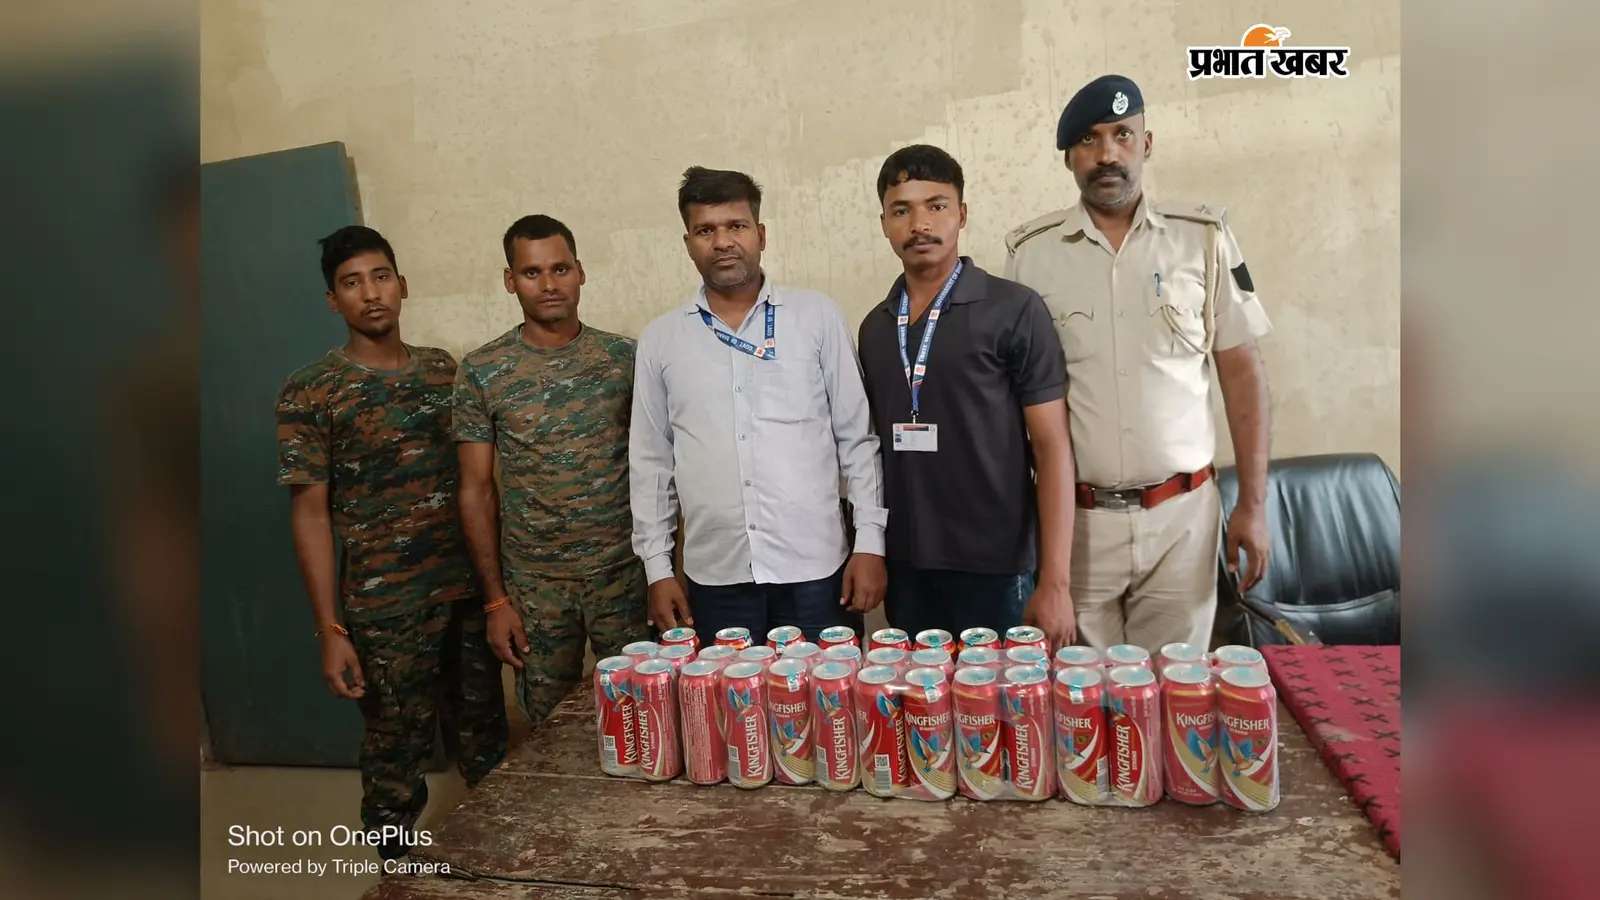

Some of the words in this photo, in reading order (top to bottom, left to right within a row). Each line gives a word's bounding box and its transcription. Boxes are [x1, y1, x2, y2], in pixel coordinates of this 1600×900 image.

[622, 701, 638, 764] KINGFISHER
[637, 709, 654, 770] KINGFISHER
[745, 712, 763, 778] KINGFISHER
[832, 716, 852, 781] KINGFISHER
[1015, 723, 1034, 790] KINGFISHER
[1116, 724, 1135, 792] KINGFISHER
